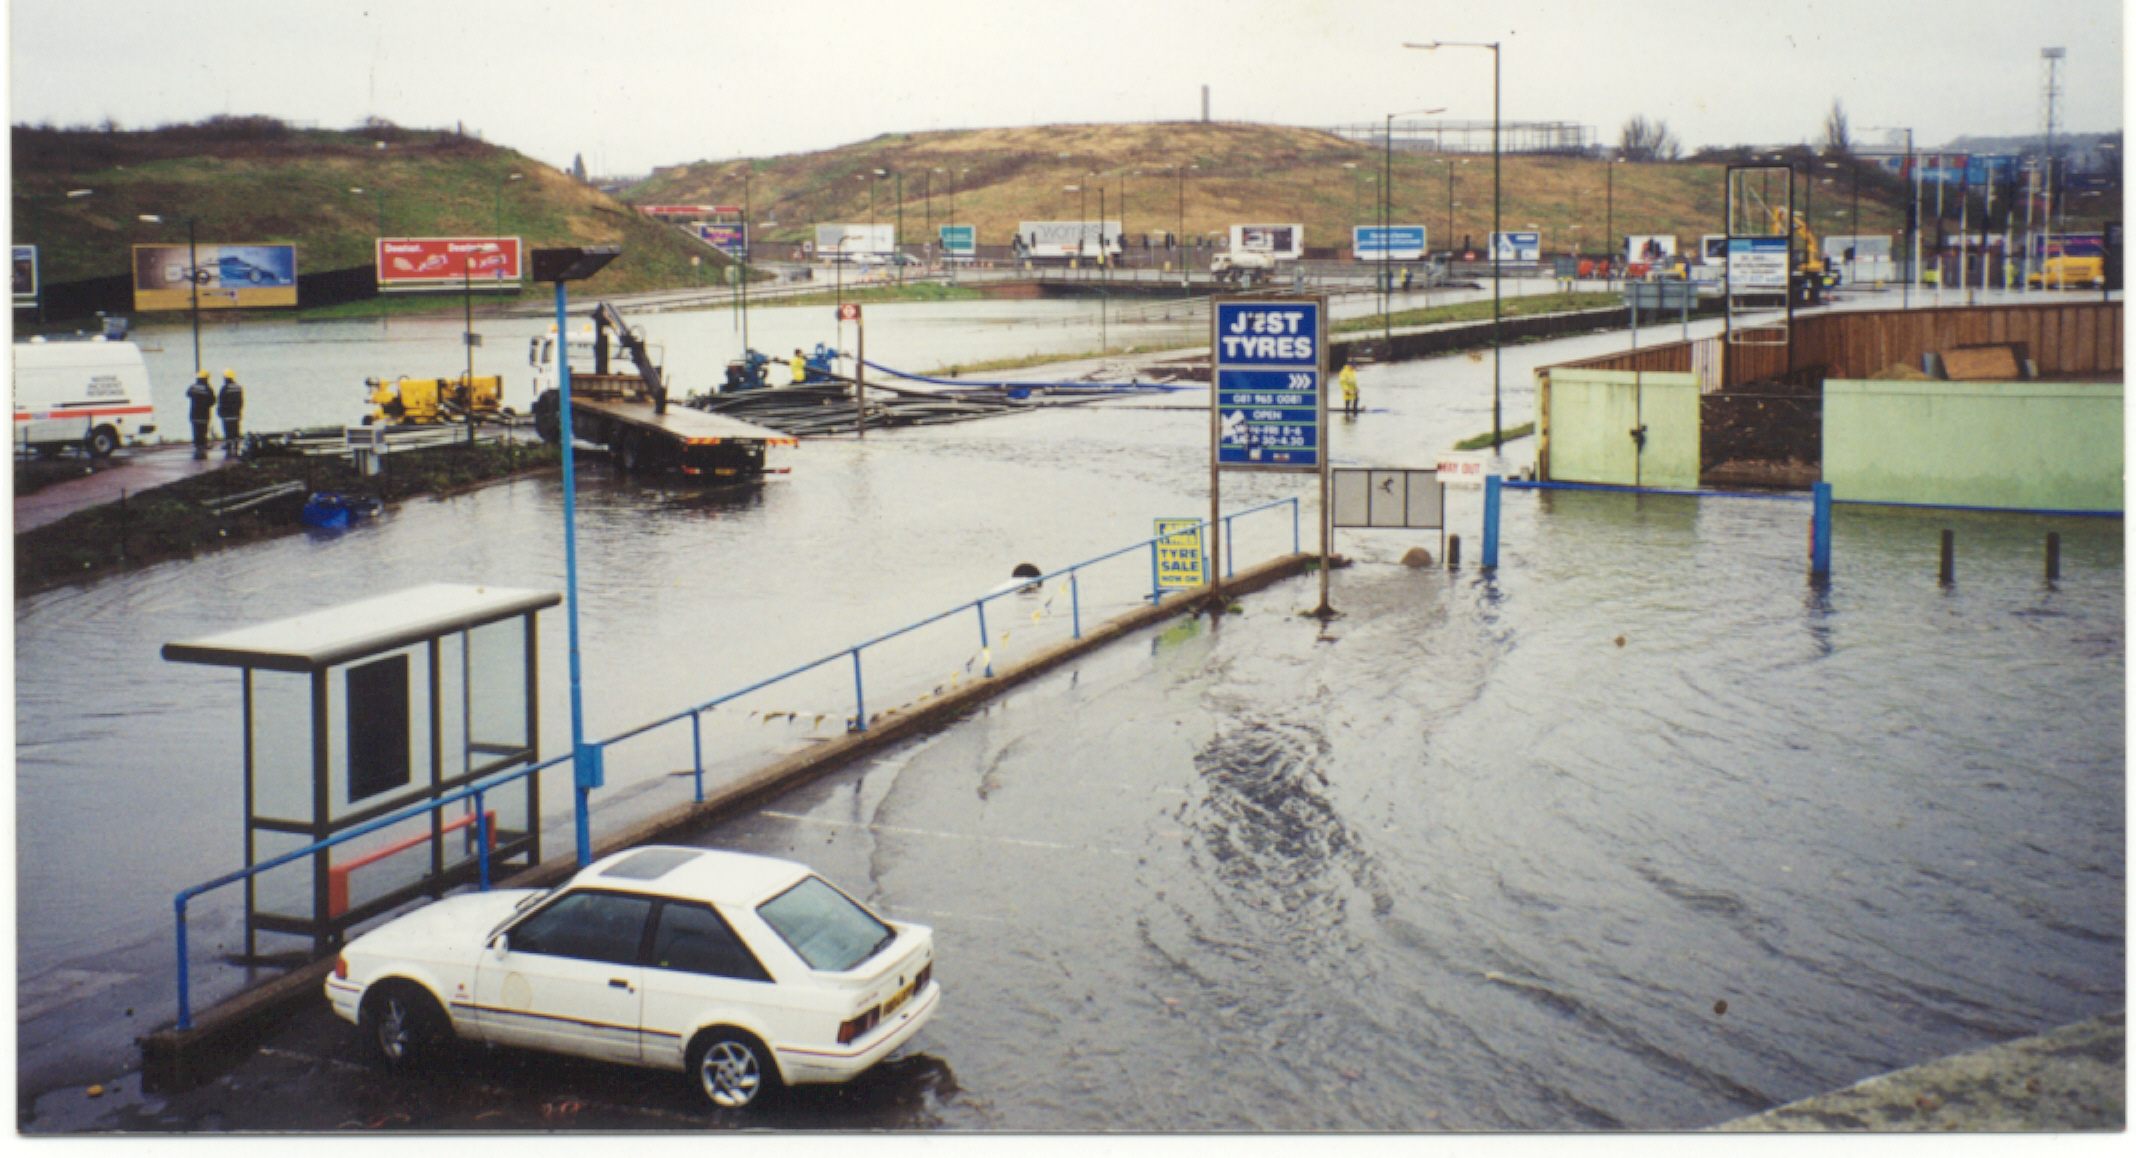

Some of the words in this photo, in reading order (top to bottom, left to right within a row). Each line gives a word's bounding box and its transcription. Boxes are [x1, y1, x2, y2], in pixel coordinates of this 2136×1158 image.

[1222, 336, 1312, 359] TYRES
[1253, 410, 1282, 420] OPEN
[1461, 463, 1481, 474] OUT
[1160, 549, 1198, 558] TYRE
[1161, 561, 1199, 571] SALE
